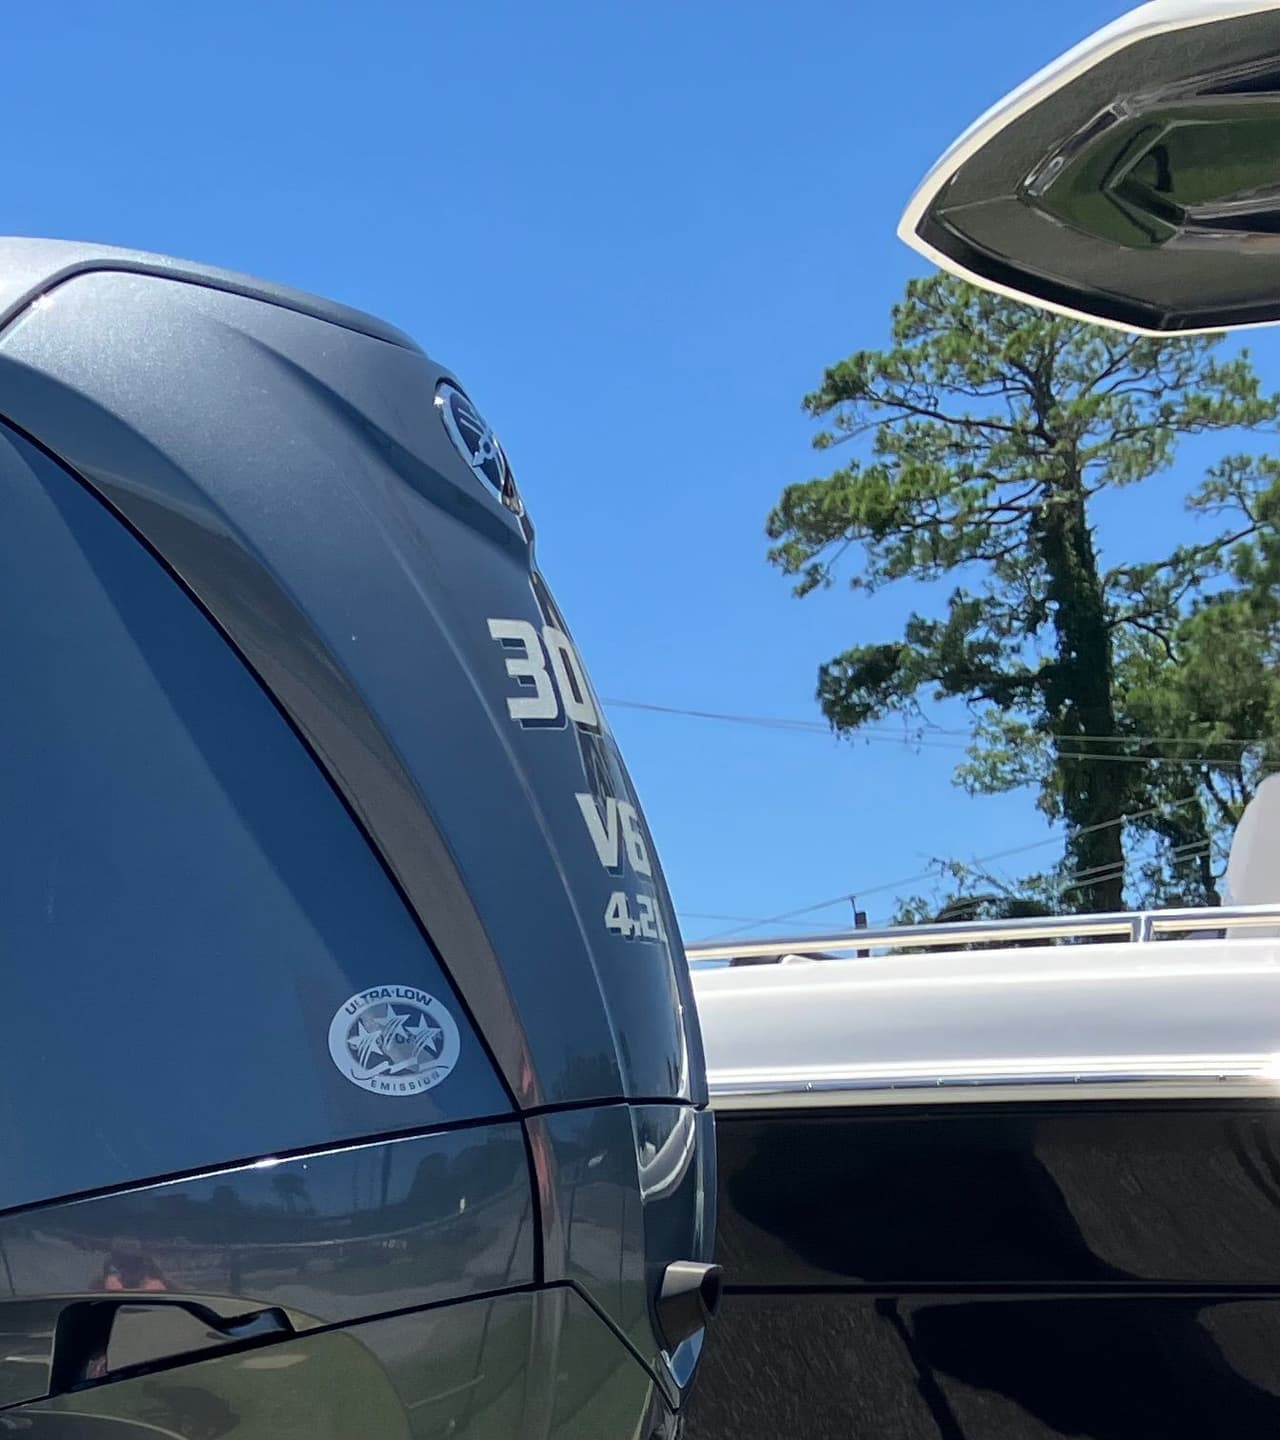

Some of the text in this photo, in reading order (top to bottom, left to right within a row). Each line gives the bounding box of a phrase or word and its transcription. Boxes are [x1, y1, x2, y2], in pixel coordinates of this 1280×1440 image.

[487, 618, 599, 727] 30
[575, 792, 652, 877] V6
[370, 1070, 441, 1092] EMISSION
